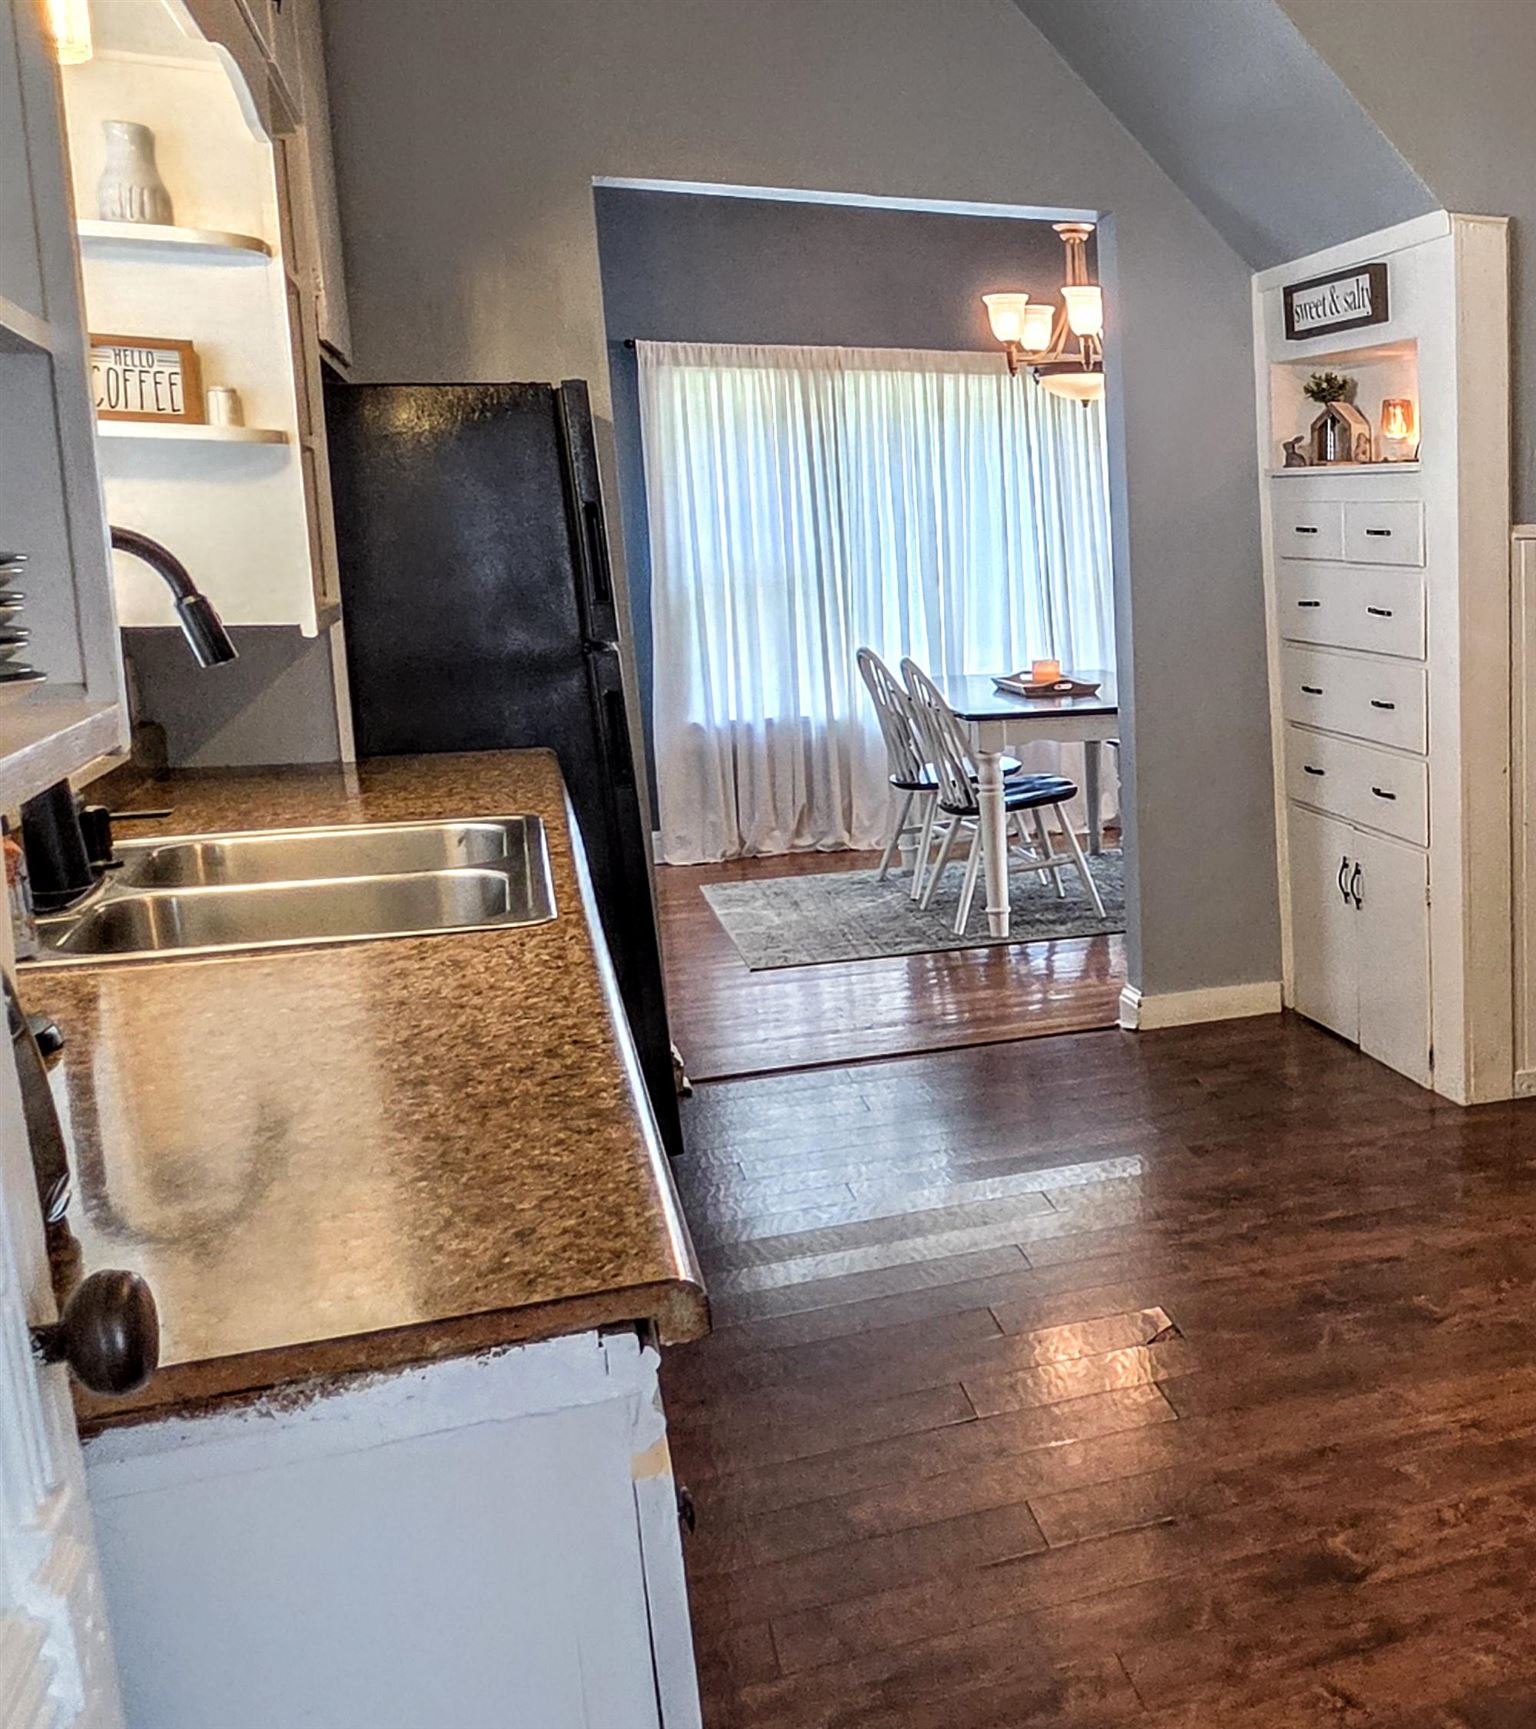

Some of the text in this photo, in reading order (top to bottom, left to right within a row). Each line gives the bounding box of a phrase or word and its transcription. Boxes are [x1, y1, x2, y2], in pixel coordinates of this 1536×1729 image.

[1294, 292, 1328, 324] sweet
[1343, 278, 1373, 314] salty
[112, 348, 155, 369] HELLO
